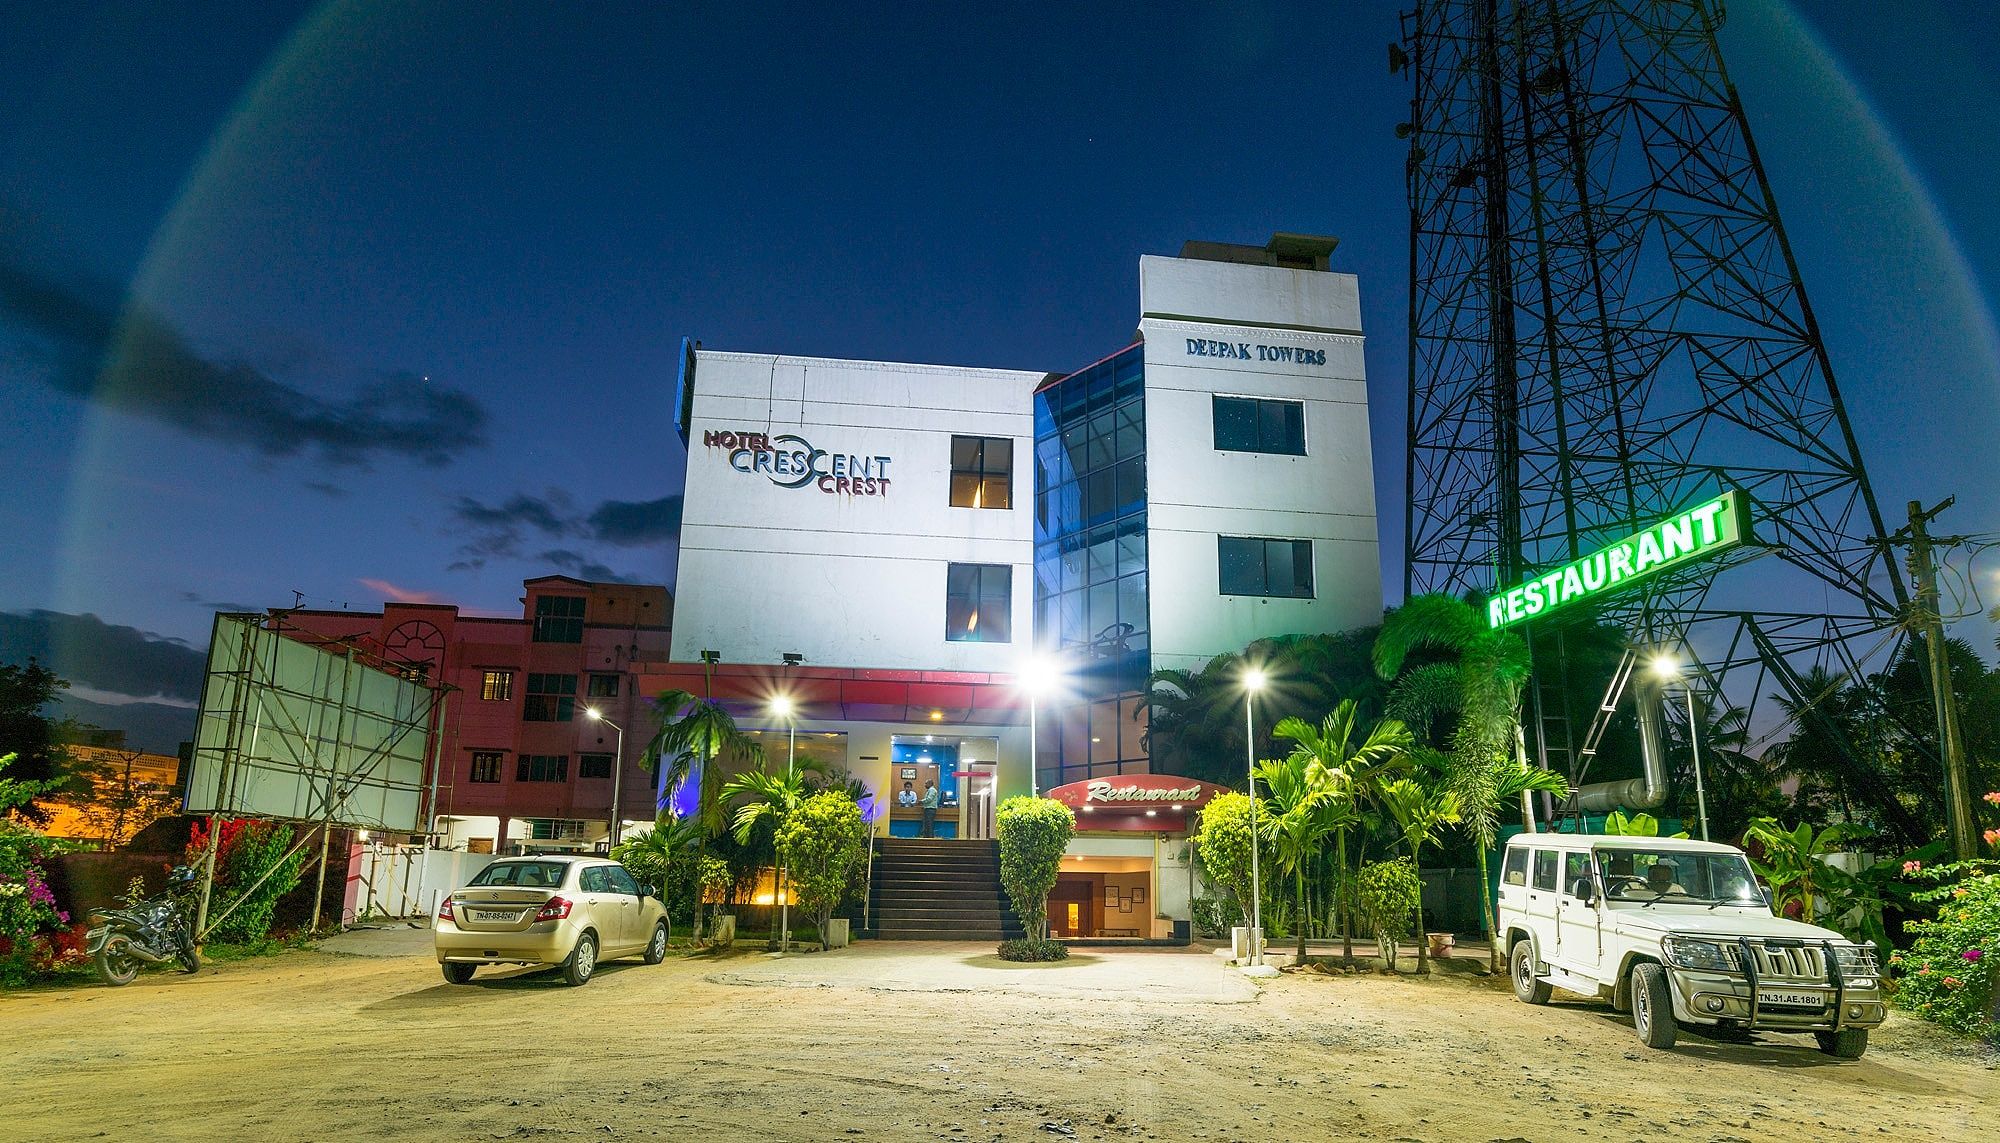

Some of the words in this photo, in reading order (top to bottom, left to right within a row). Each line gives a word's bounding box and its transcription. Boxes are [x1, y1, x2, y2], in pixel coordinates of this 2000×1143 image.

[1186, 338, 1251, 360] DEEPAK
[1257, 344, 1327, 366] TOWERS
[703, 429, 775, 451] HOTEL
[729, 448, 892, 481] CRESCENT
[818, 475, 892, 497] CREST
[1489, 500, 1728, 630] RESTAURANT
[1086, 781, 1202, 803] Restaurant
[1759, 993, 1821, 1005] TN.31.AE.1801
